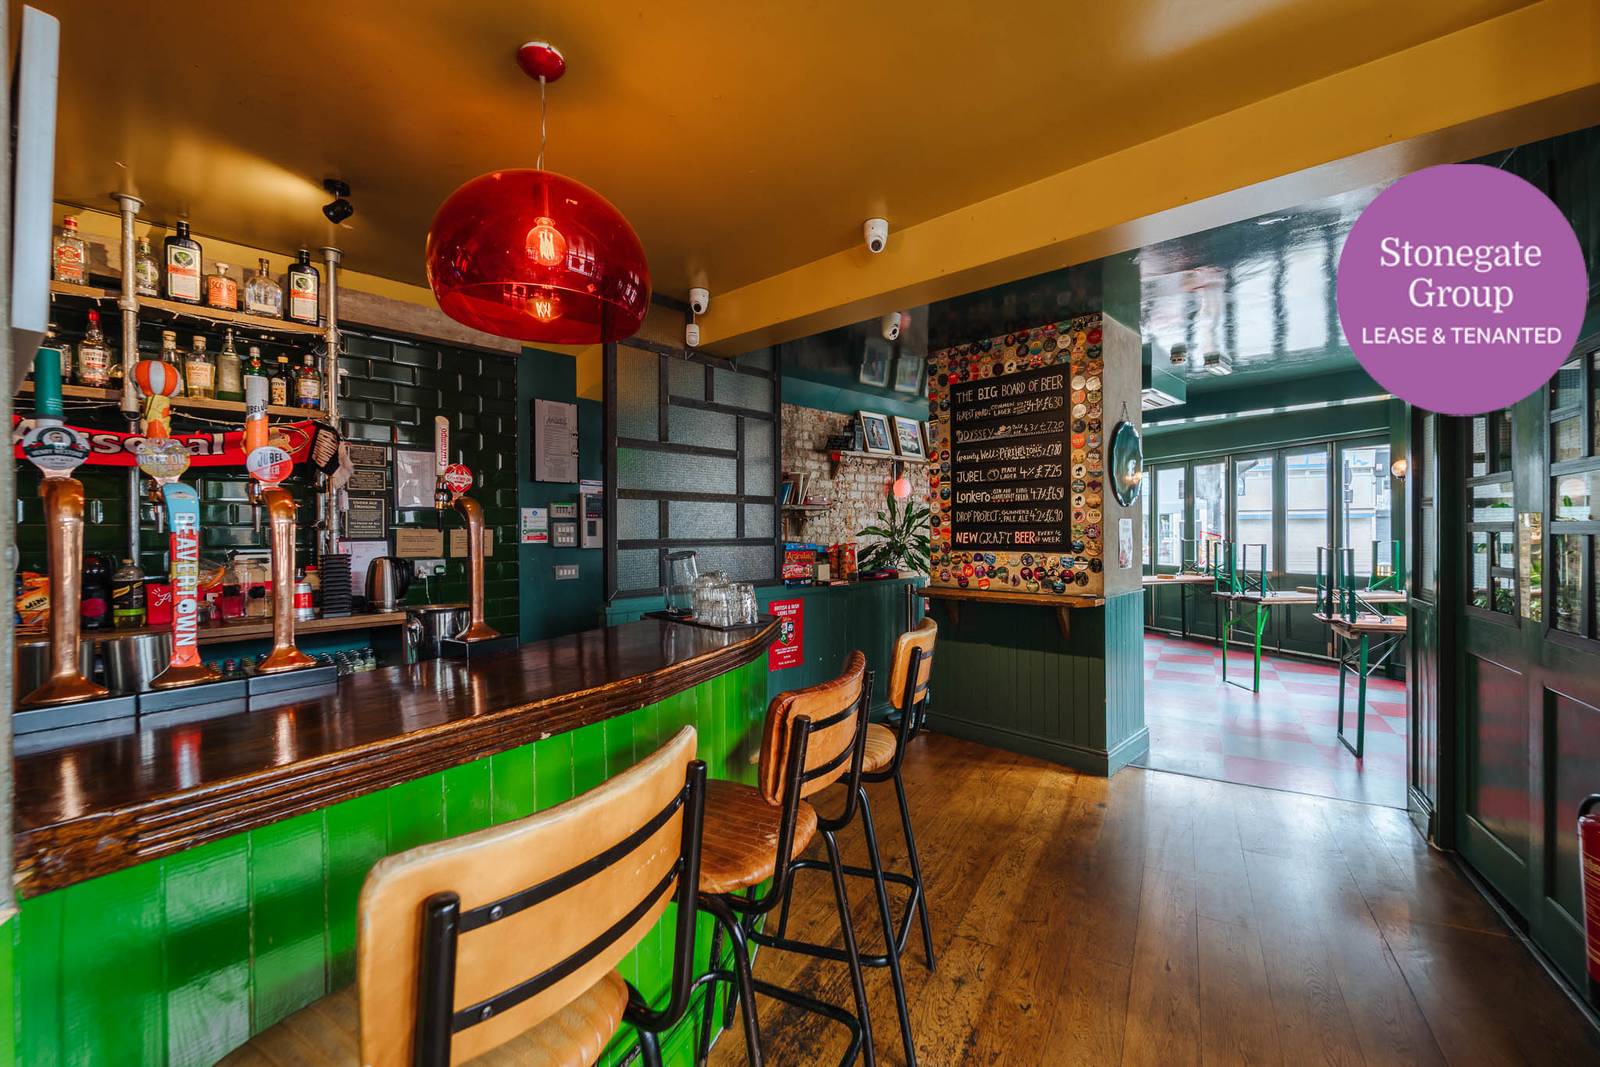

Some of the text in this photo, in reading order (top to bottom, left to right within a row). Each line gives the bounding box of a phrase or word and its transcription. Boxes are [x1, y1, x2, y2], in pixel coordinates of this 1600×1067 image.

[956, 374, 1064, 404] THE BIG BOARD OF BEER
[956, 427, 995, 442] ODYSSEY
[956, 470, 986, 483] JUBEL
[956, 490, 991, 504] Lonkero
[956, 511, 971, 523] DROP
[955, 532, 979, 544] NEW
[979, 531, 1012, 545] CRAFT
[1014, 531, 1036, 544] BEER
[174, 512, 198, 647] BEAVERTOWN
